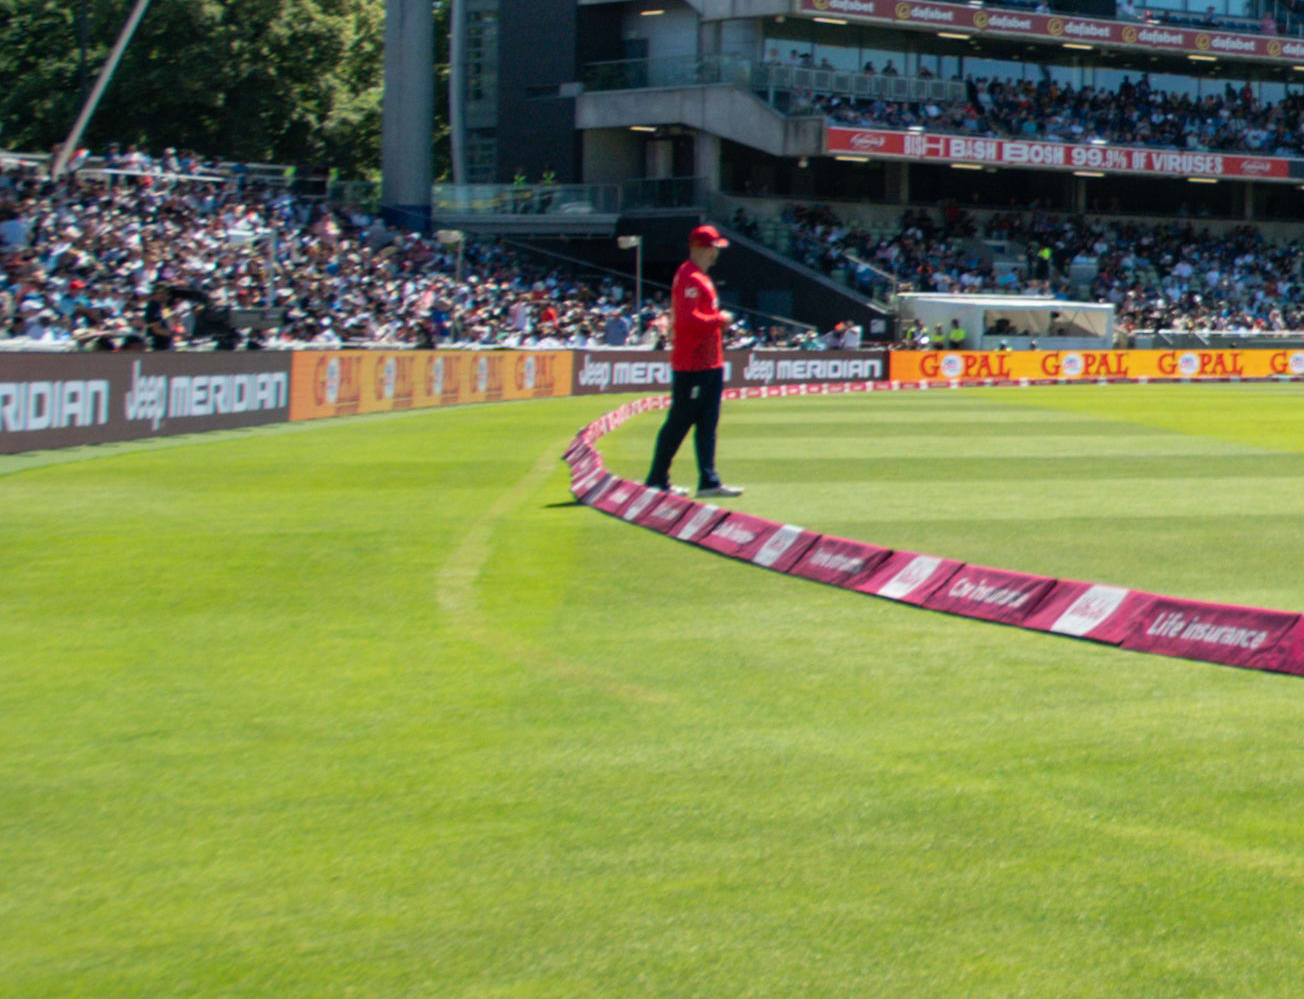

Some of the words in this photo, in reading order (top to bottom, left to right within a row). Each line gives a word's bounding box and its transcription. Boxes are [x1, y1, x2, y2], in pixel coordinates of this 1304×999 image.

[911, 6, 953, 21] dafabet
[988, 15, 1031, 30] dafabet
[1064, 21, 1110, 37] dafabet
[1138, 31, 1183, 45] dafabet
[1212, 38, 1255, 52] dafabet
[904, 135, 944, 157] BISH
[951, 139, 996, 160] BASH
[1002, 142, 1064, 165] BOSH
[1071, 147, 1127, 169] 99.9%
[1132, 152, 1146, 169] OF
[1152, 153, 1223, 174] VIRUSES
[578, 353, 610, 390] Jeep
[744, 353, 774, 382] Jeep
[777, 359, 882, 379] MERIDIAN
[125, 359, 167, 431] Jeep
[169, 371, 288, 418] MERIDIAN
[1147, 612, 1184, 636] Life
[1181, 617, 1267, 650] insurance
